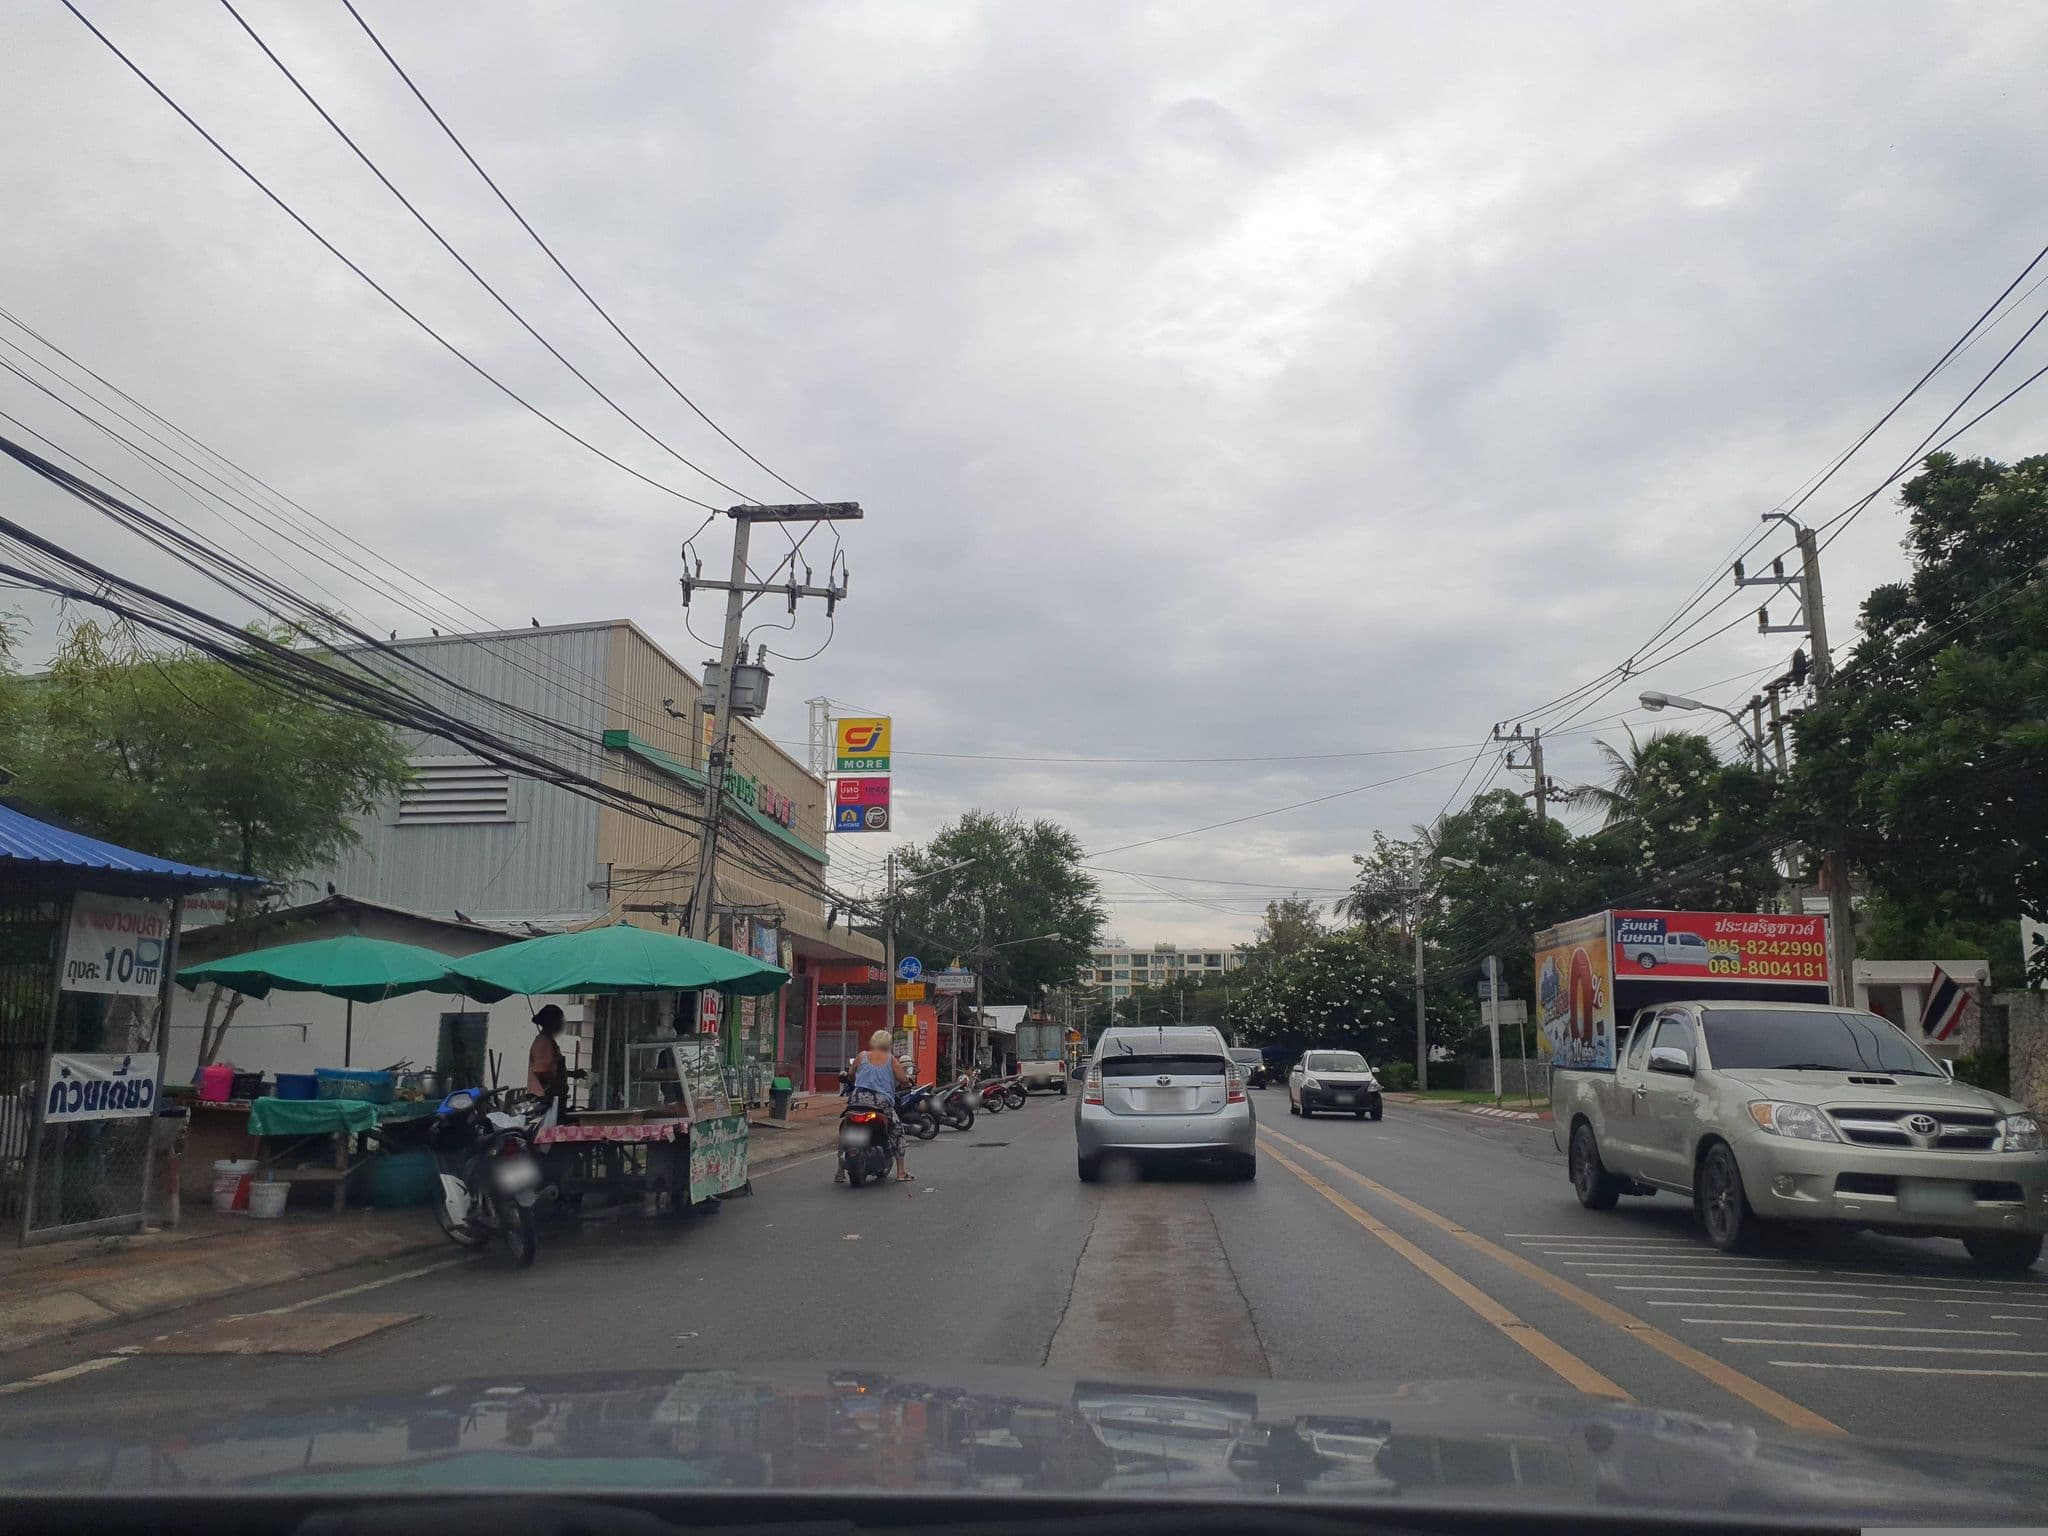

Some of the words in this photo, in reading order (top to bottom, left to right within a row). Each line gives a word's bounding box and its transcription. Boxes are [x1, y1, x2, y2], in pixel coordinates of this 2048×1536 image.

[843, 759, 883, 769] MORE
[1620, 918, 1659, 931] รับแห่
[1616, 929, 1664, 944] โฆษณา
[1707, 939, 1824, 957] 085-8242990
[67, 959, 101, 985] ถุงละ
[104, 945, 135, 983] 10
[136, 967, 158, 986] บาท
[1707, 959, 1824, 978] 089-8004181
